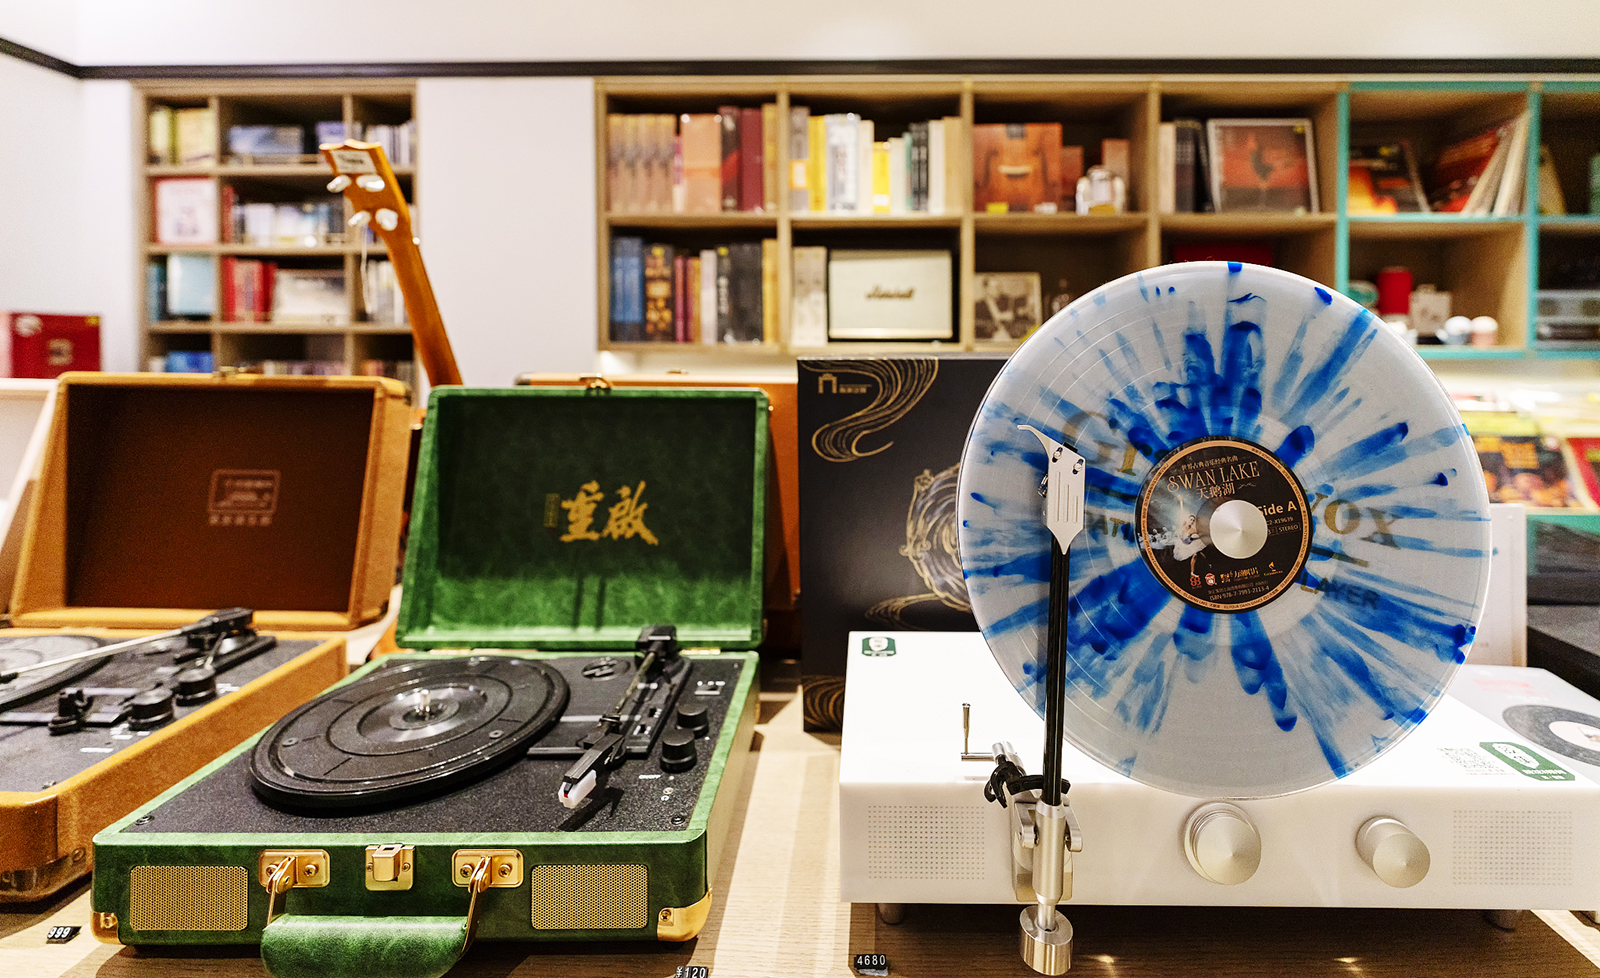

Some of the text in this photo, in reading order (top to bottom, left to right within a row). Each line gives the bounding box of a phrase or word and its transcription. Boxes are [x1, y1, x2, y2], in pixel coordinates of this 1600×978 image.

[1167, 469, 1216, 493] SWAN
[1220, 461, 1260, 483] LAKE
[1199, 482, 1236, 499] 天鹅湖
[1288, 500, 1298, 512] A
[47, 926, 71, 939] 999
[857, 954, 886, 966] 4680
[676, 966, 706, 978] ¥120
